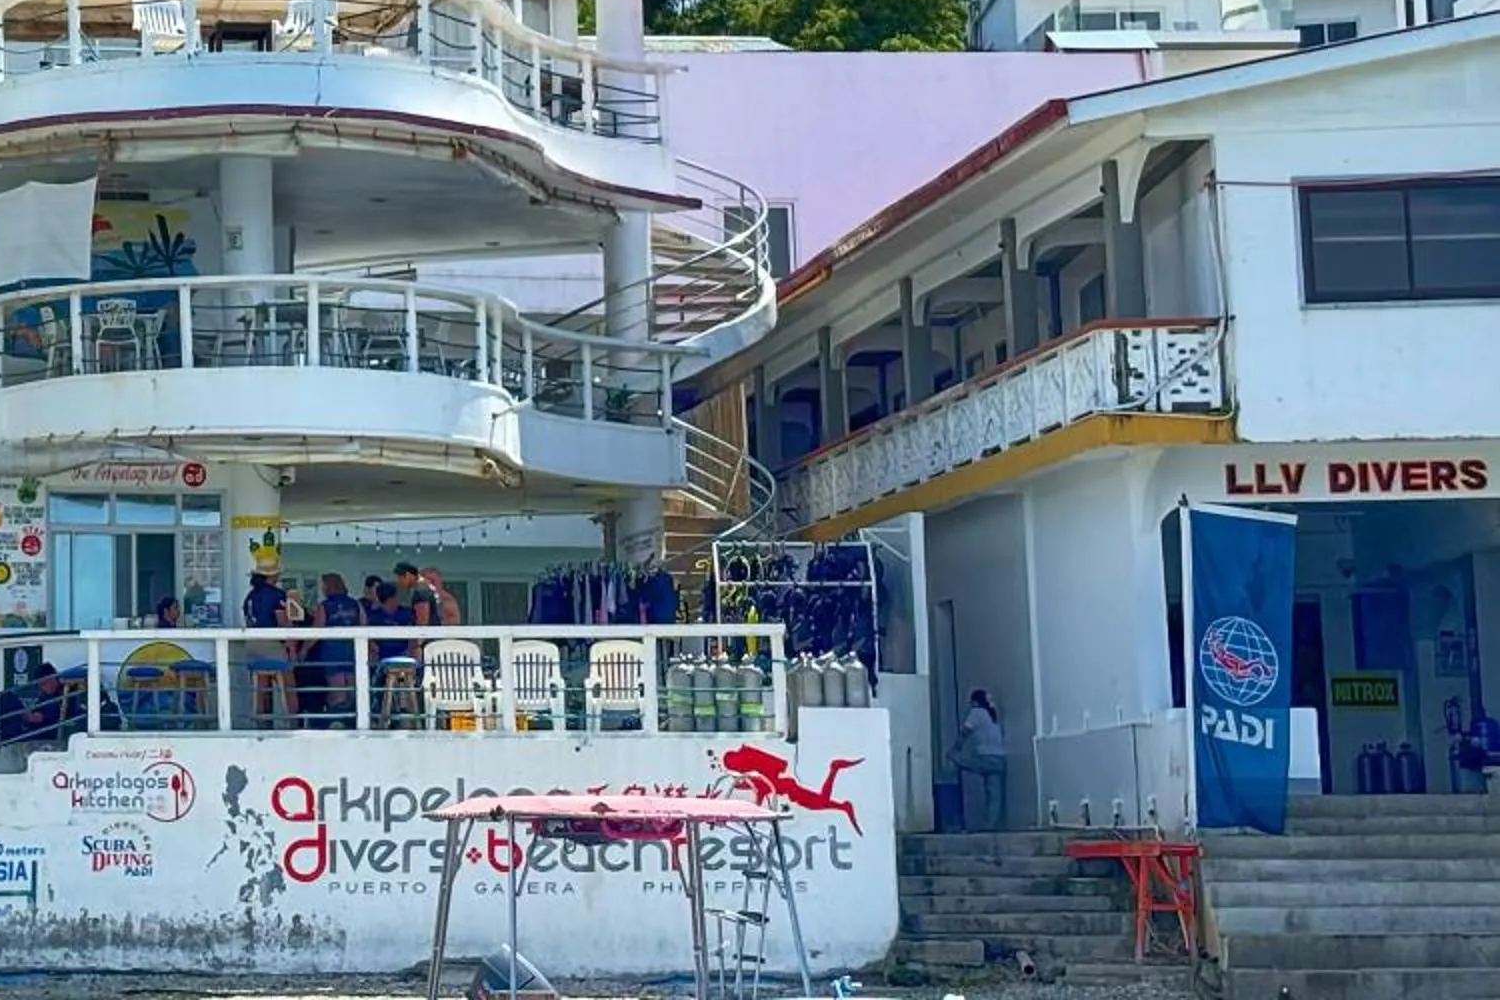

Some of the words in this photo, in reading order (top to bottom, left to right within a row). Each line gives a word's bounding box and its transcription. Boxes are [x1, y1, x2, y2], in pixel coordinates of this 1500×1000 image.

[1225, 463, 1306, 495] LLV
[1328, 459, 1488, 493] DIVERS
[1201, 703, 1275, 750] PADI
[271, 776, 571, 834] arkipel
[5, 845, 45, 856] meters
[92, 852, 153, 872] DIVING
[329, 881, 427, 895] PUERTO
[474, 881, 575, 895] GAERA
